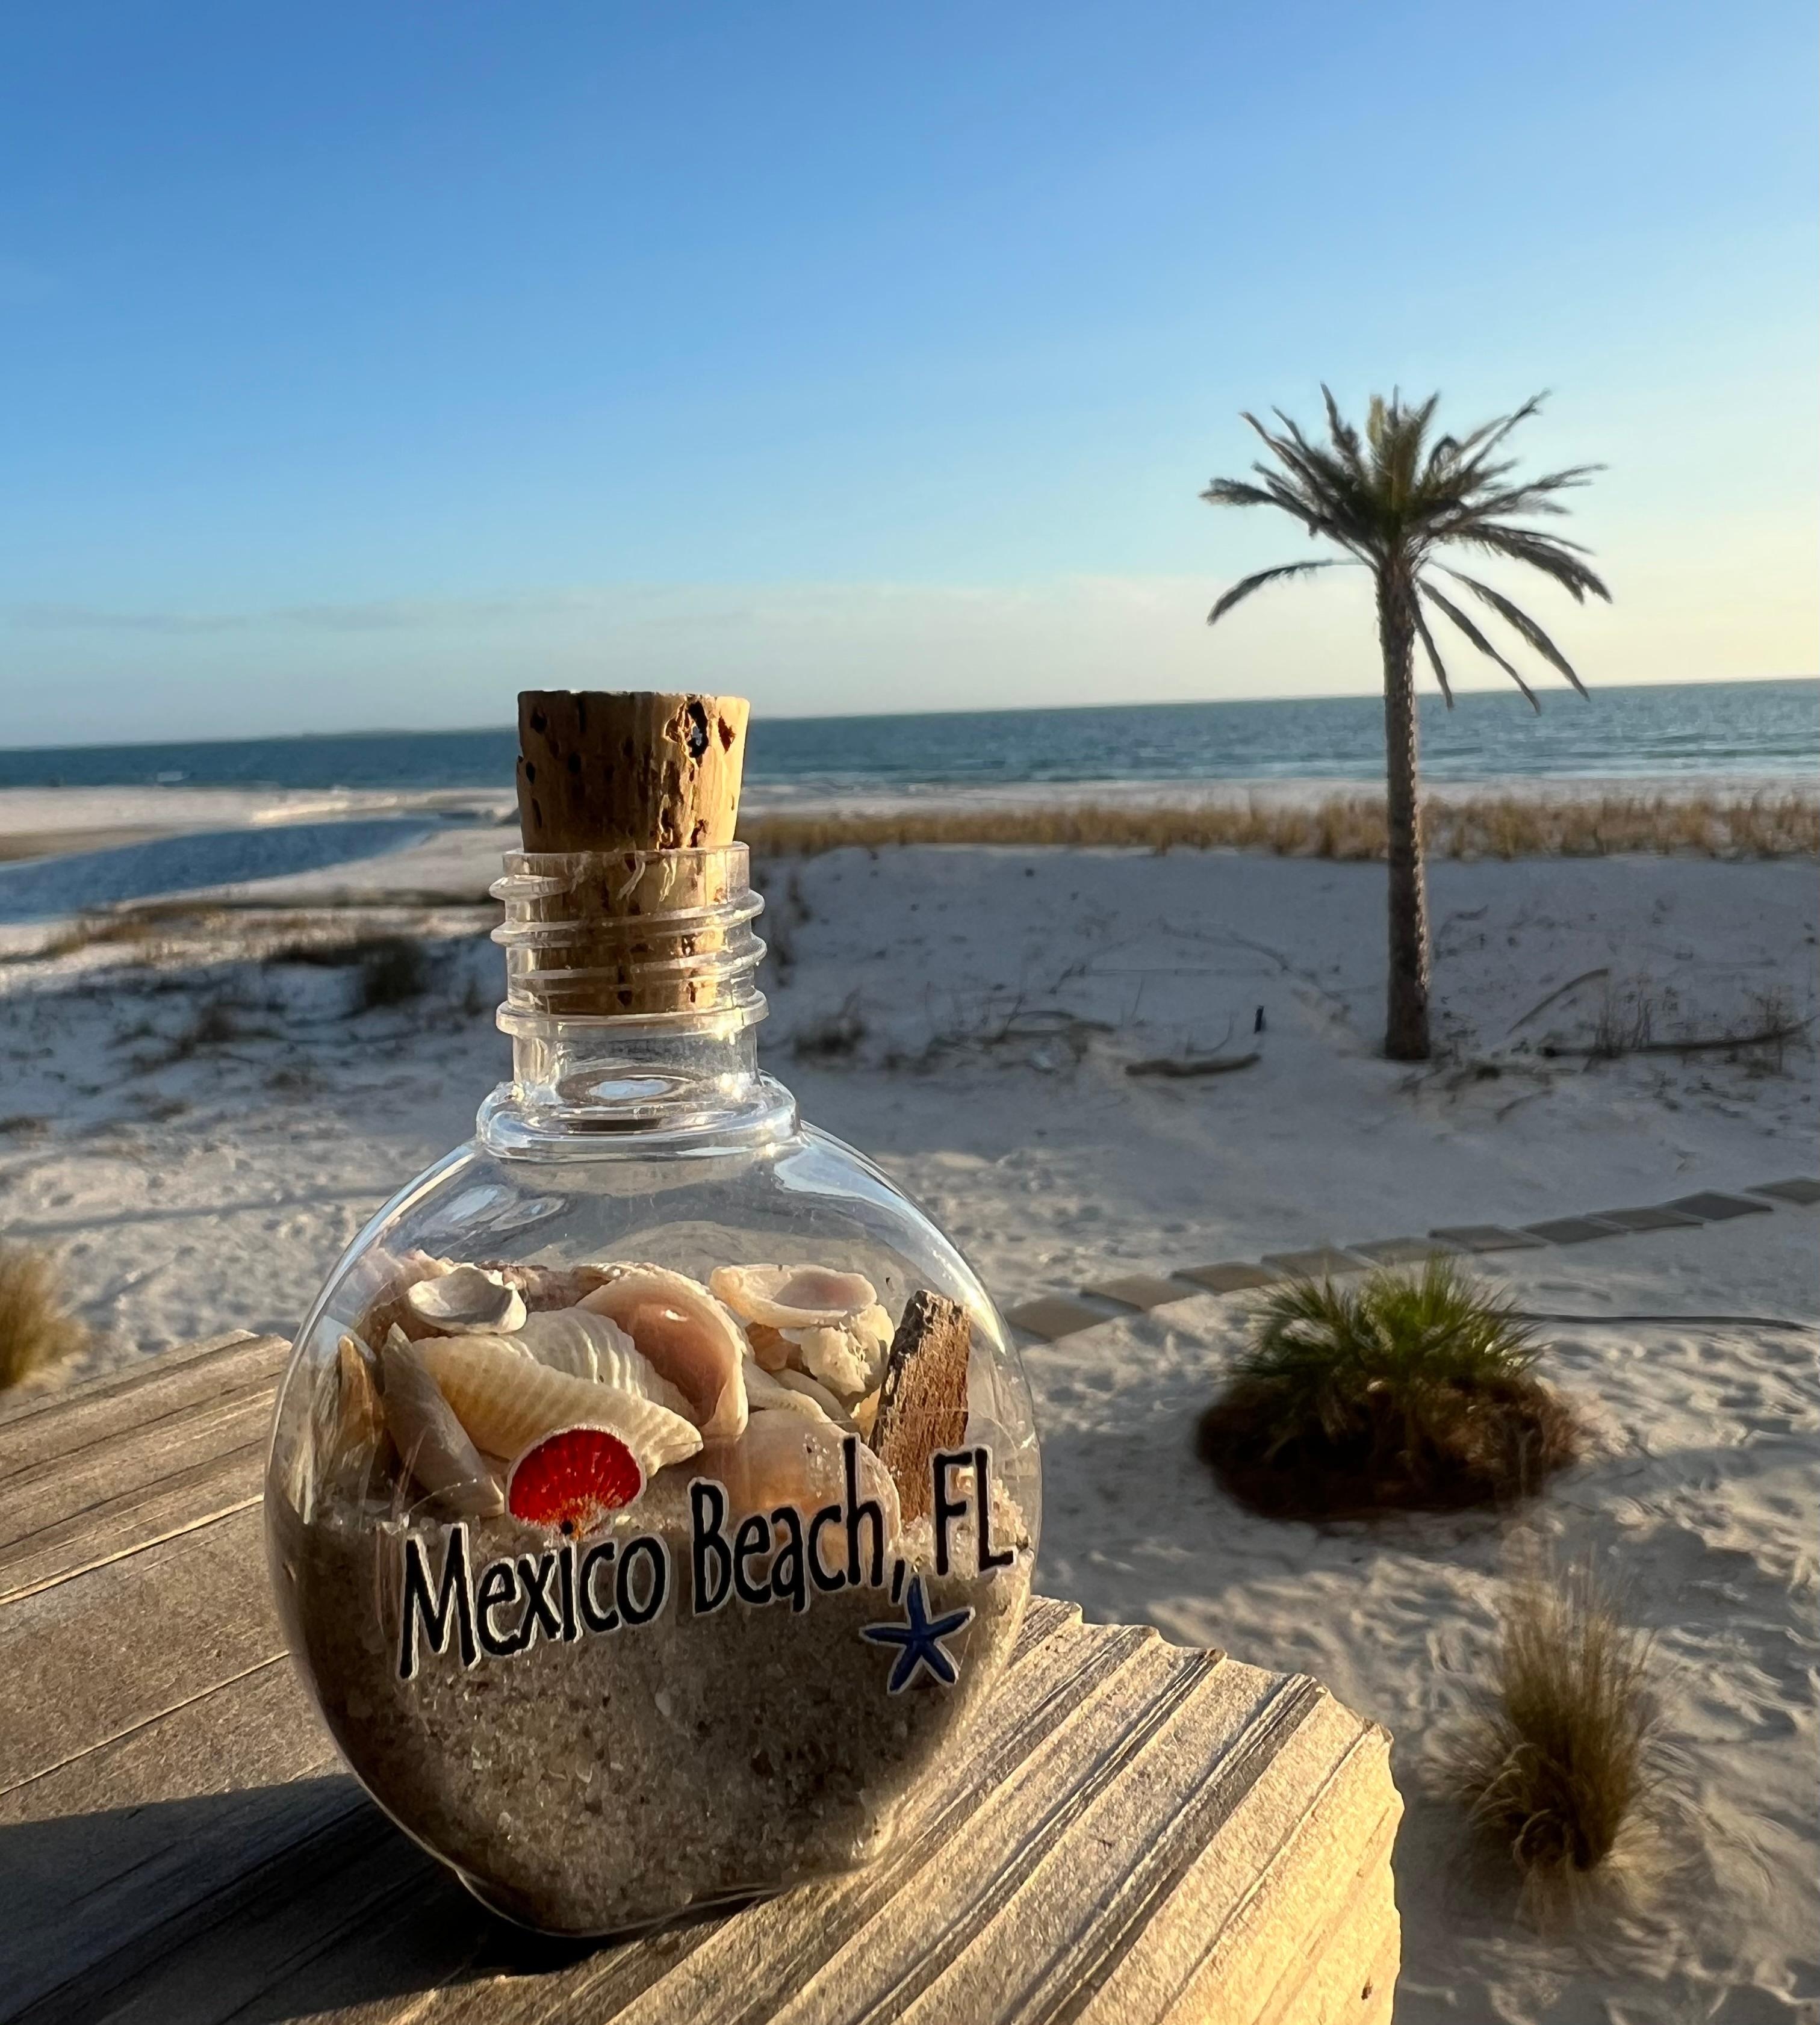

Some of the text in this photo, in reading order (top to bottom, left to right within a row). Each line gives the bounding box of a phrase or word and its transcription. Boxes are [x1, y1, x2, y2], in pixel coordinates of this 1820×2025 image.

[398, 1434, 1016, 1678] Mexico Beach, FL
